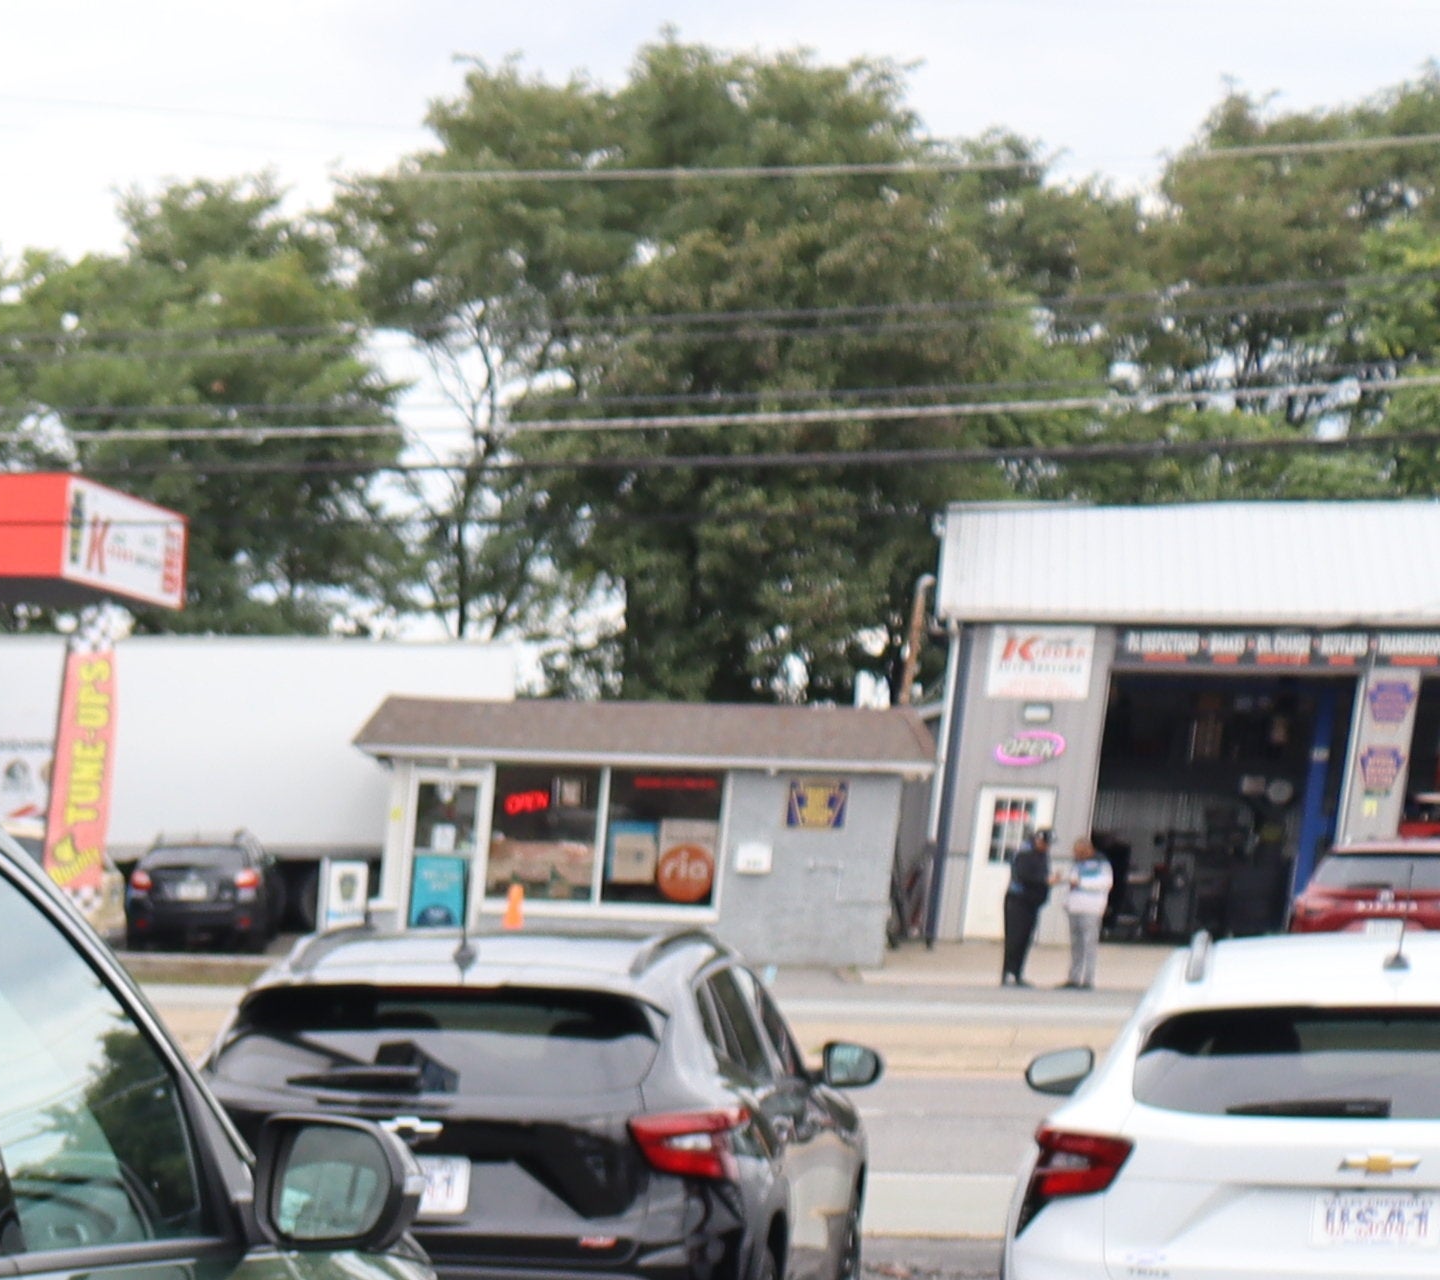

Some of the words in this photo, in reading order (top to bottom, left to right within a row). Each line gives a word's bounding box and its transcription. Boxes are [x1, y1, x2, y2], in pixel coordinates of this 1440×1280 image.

[64, 658, 111, 827] TUNE-UPS
[1003, 738, 1056, 759] OPEN
[503, 789, 550, 817] OPEN
